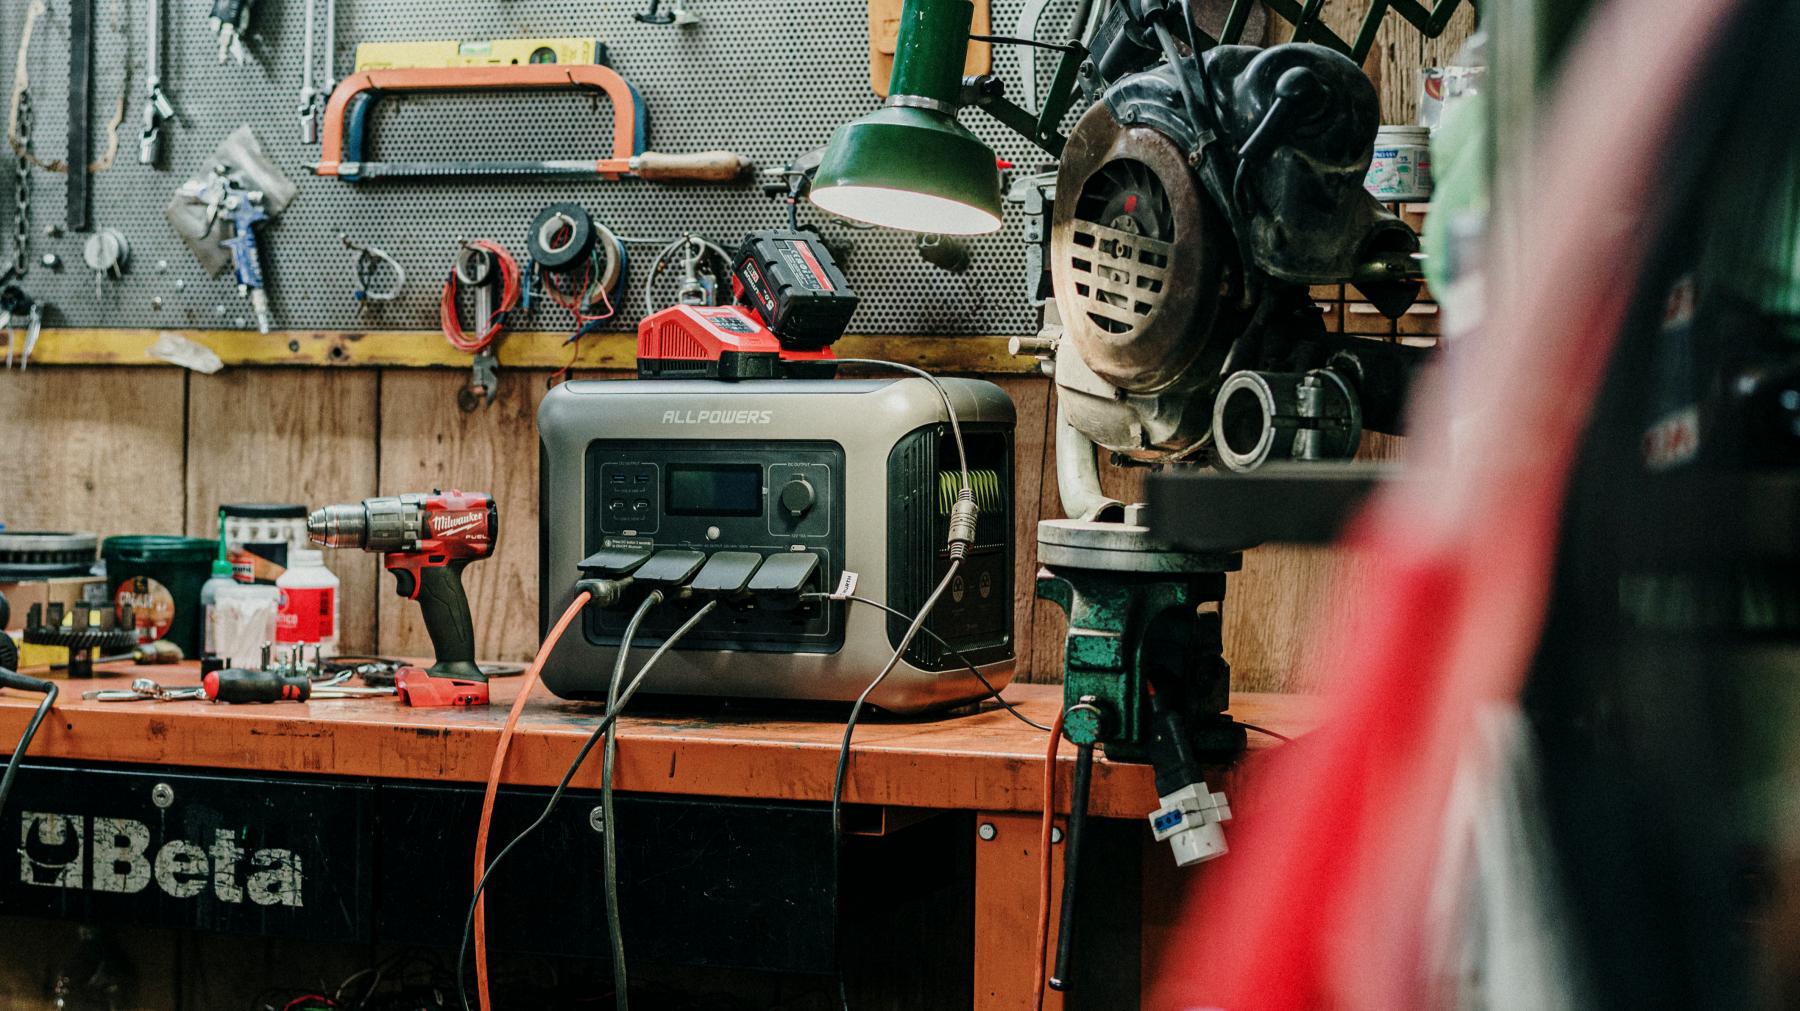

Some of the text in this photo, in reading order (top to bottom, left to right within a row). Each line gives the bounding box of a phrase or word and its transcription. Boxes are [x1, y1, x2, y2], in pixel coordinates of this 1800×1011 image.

[662, 410, 773, 424] ALLPOWERS
[433, 511, 483, 531] Milwaukee
[92, 816, 304, 907] Beta
